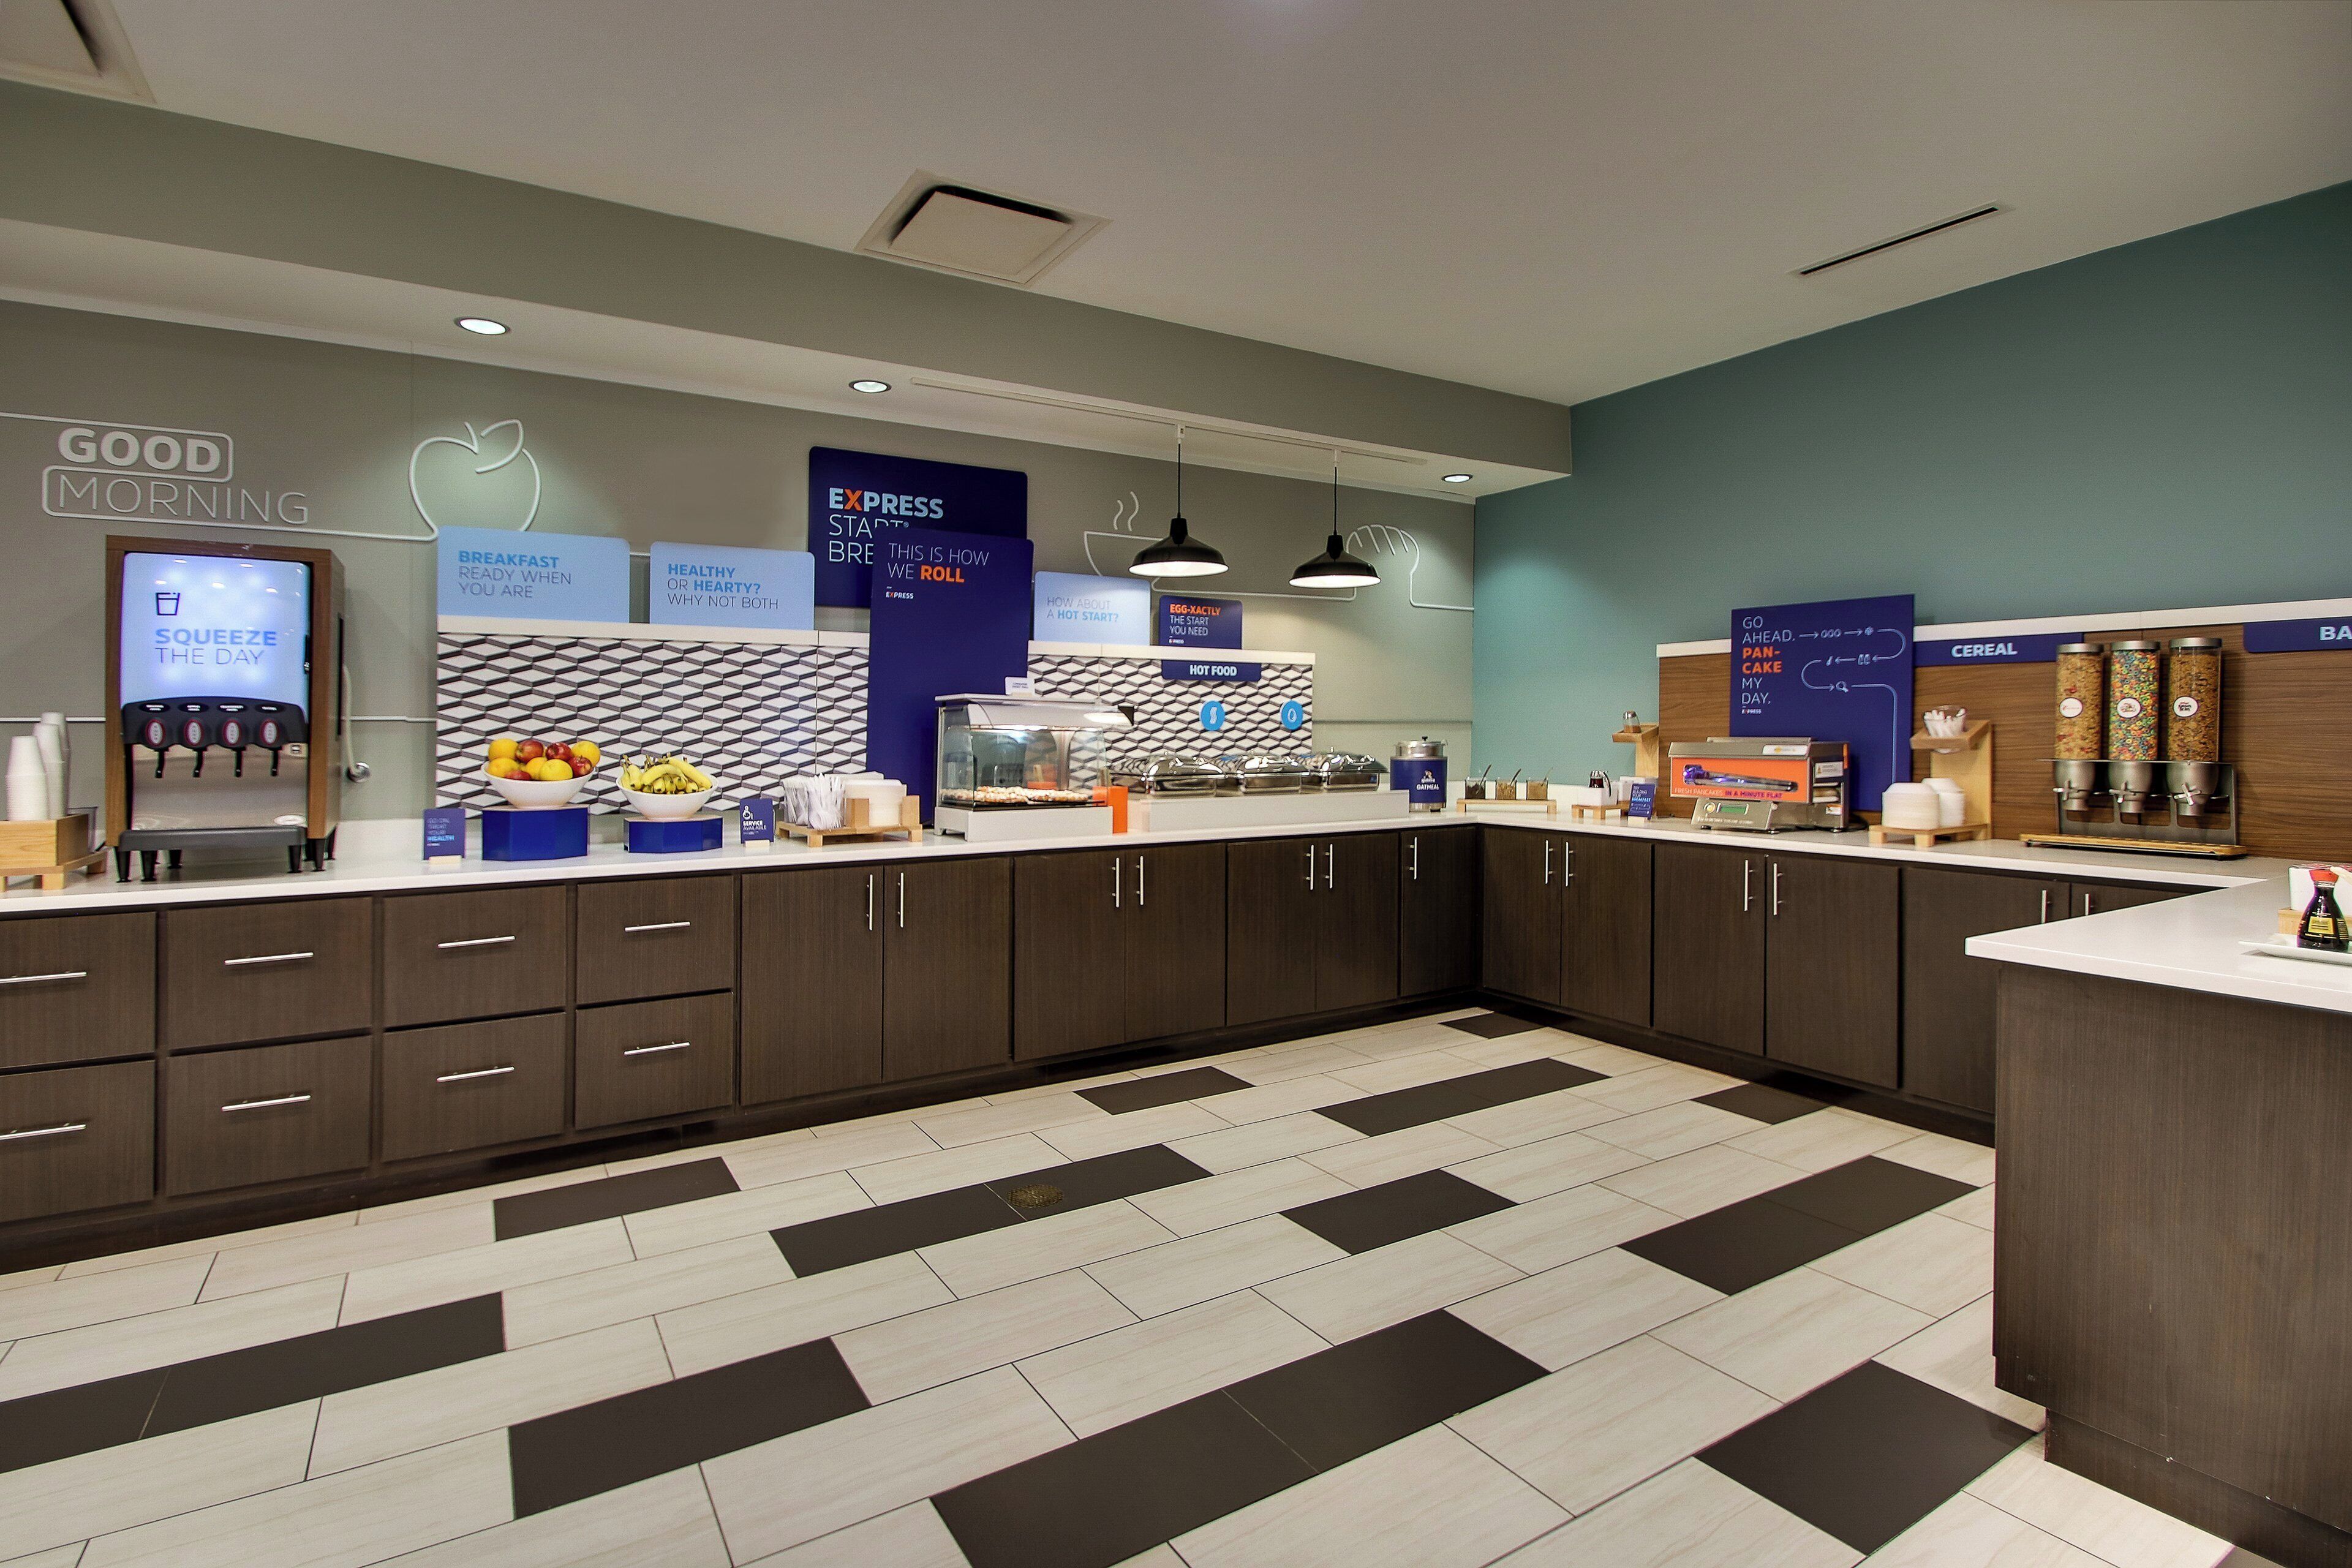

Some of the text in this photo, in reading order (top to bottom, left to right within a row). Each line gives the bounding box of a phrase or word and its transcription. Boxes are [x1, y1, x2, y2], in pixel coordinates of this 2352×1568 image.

[58, 428, 221, 473] GOOD
[59, 474, 307, 525] MORNING
[829, 488, 944, 519] EXPRESS
[458, 551, 559, 568] BREAKFAST
[889, 543, 989, 566] THIS IS HOW
[459, 566, 571, 585] READY WHEN
[668, 564, 735, 579] HEALTHY
[888, 563, 965, 582] WE ROLL
[459, 582, 533, 598] YOU ARE
[668, 579, 761, 594] OR HEARTY?
[668, 593, 778, 609] WHY NOT BOTH
[1047, 597, 1110, 610] HOW ABOUT
[1047, 609, 1119, 622] A HOT START?
[1170, 604, 1221, 616] EGG-XACTLY
[1170, 615, 1209, 625] THE START
[1743, 616, 1763, 629] GO
[155, 628, 277, 647] SQUEEZE
[1170, 625, 1209, 636] YOU NEED
[1742, 629, 1796, 644] AHEAD.
[156, 647, 265, 665] THE DAY
[1742, 646, 1781, 659] PAN-
[1951, 643, 2018, 658] CEREAL
[1189, 665, 1237, 677] HOT FOOD
[1742, 660, 1783, 674] CAKE
[1742, 677, 1762, 690] MY
[1742, 692, 1771, 704] DAY.
